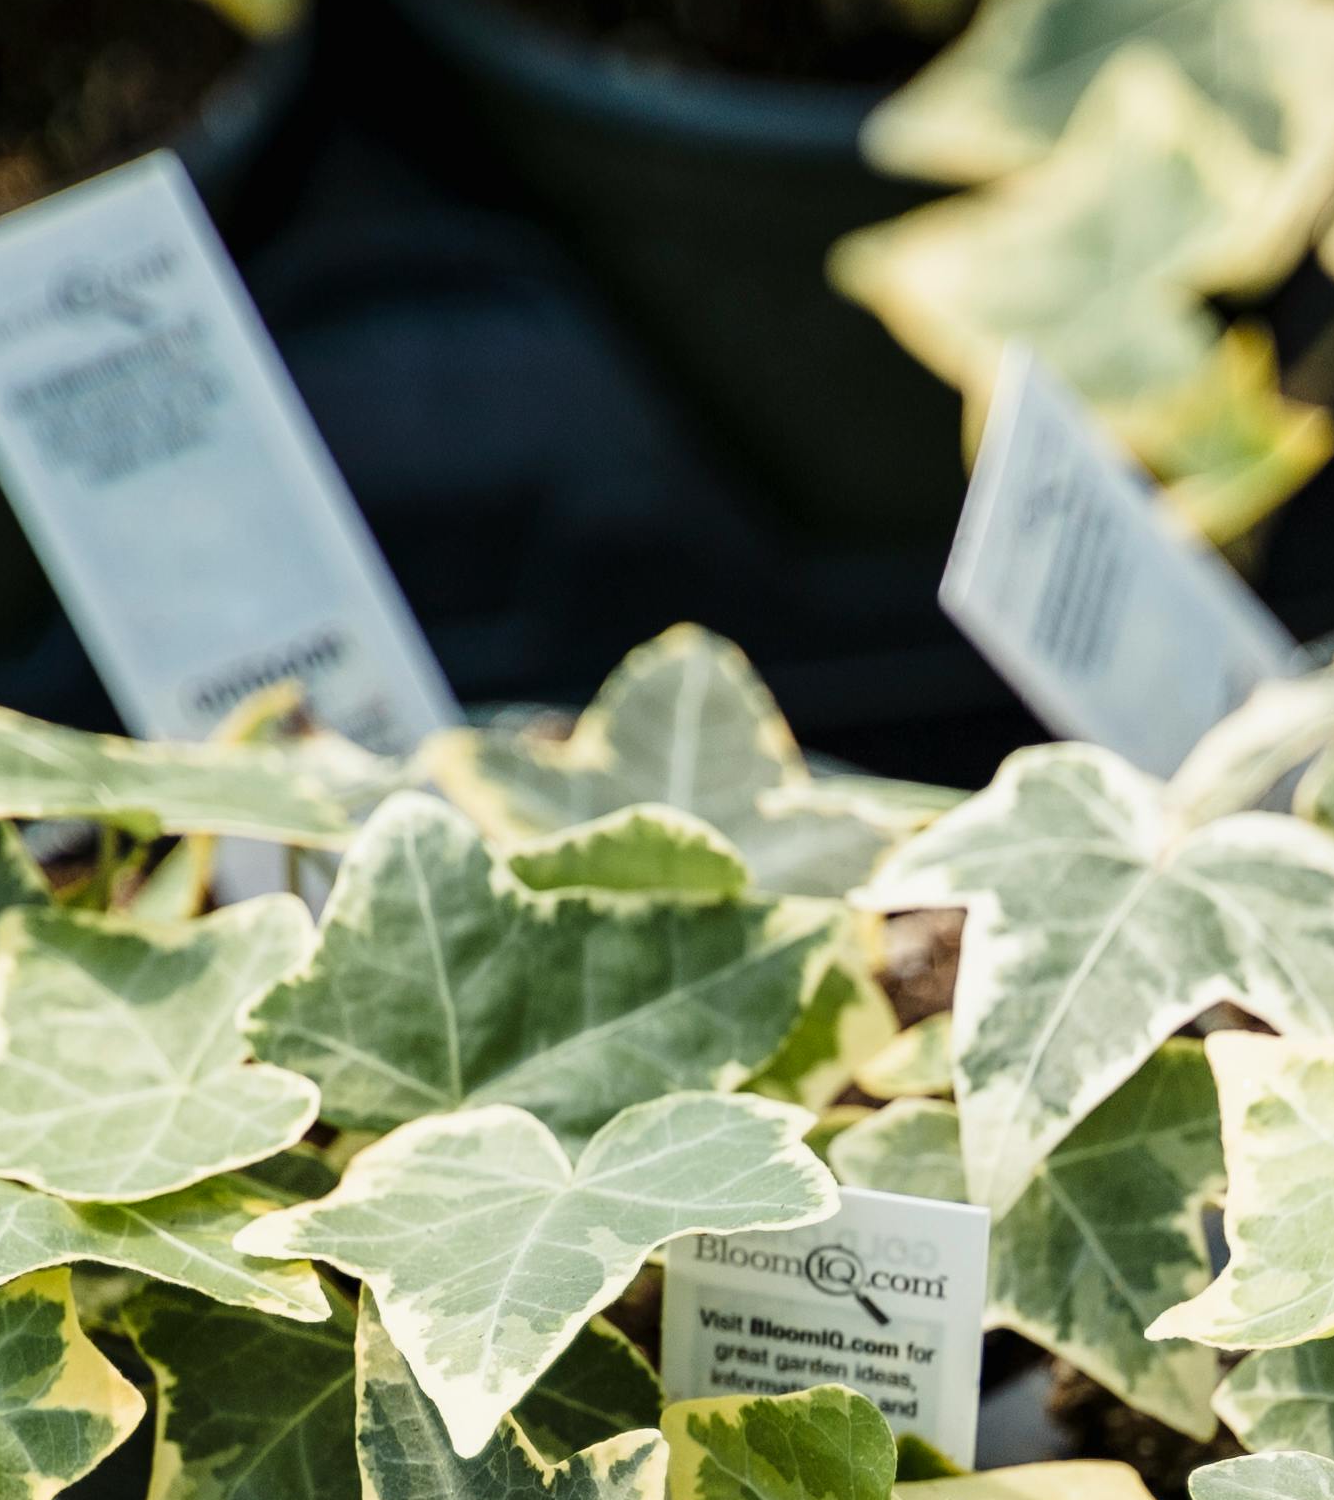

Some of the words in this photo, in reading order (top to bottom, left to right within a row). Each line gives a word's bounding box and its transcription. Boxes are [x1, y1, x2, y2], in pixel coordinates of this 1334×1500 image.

[694, 1235, 948, 1299] BloomIQ.com
[699, 1308, 743, 1333] Visit
[749, 1316, 900, 1358] BloomIQ.com
[907, 1343, 936, 1365] for
[714, 1342, 768, 1368] great
[774, 1350, 848, 1378] garden
[854, 1363, 918, 1393] ideas,
[880, 1396, 919, 1419] and
